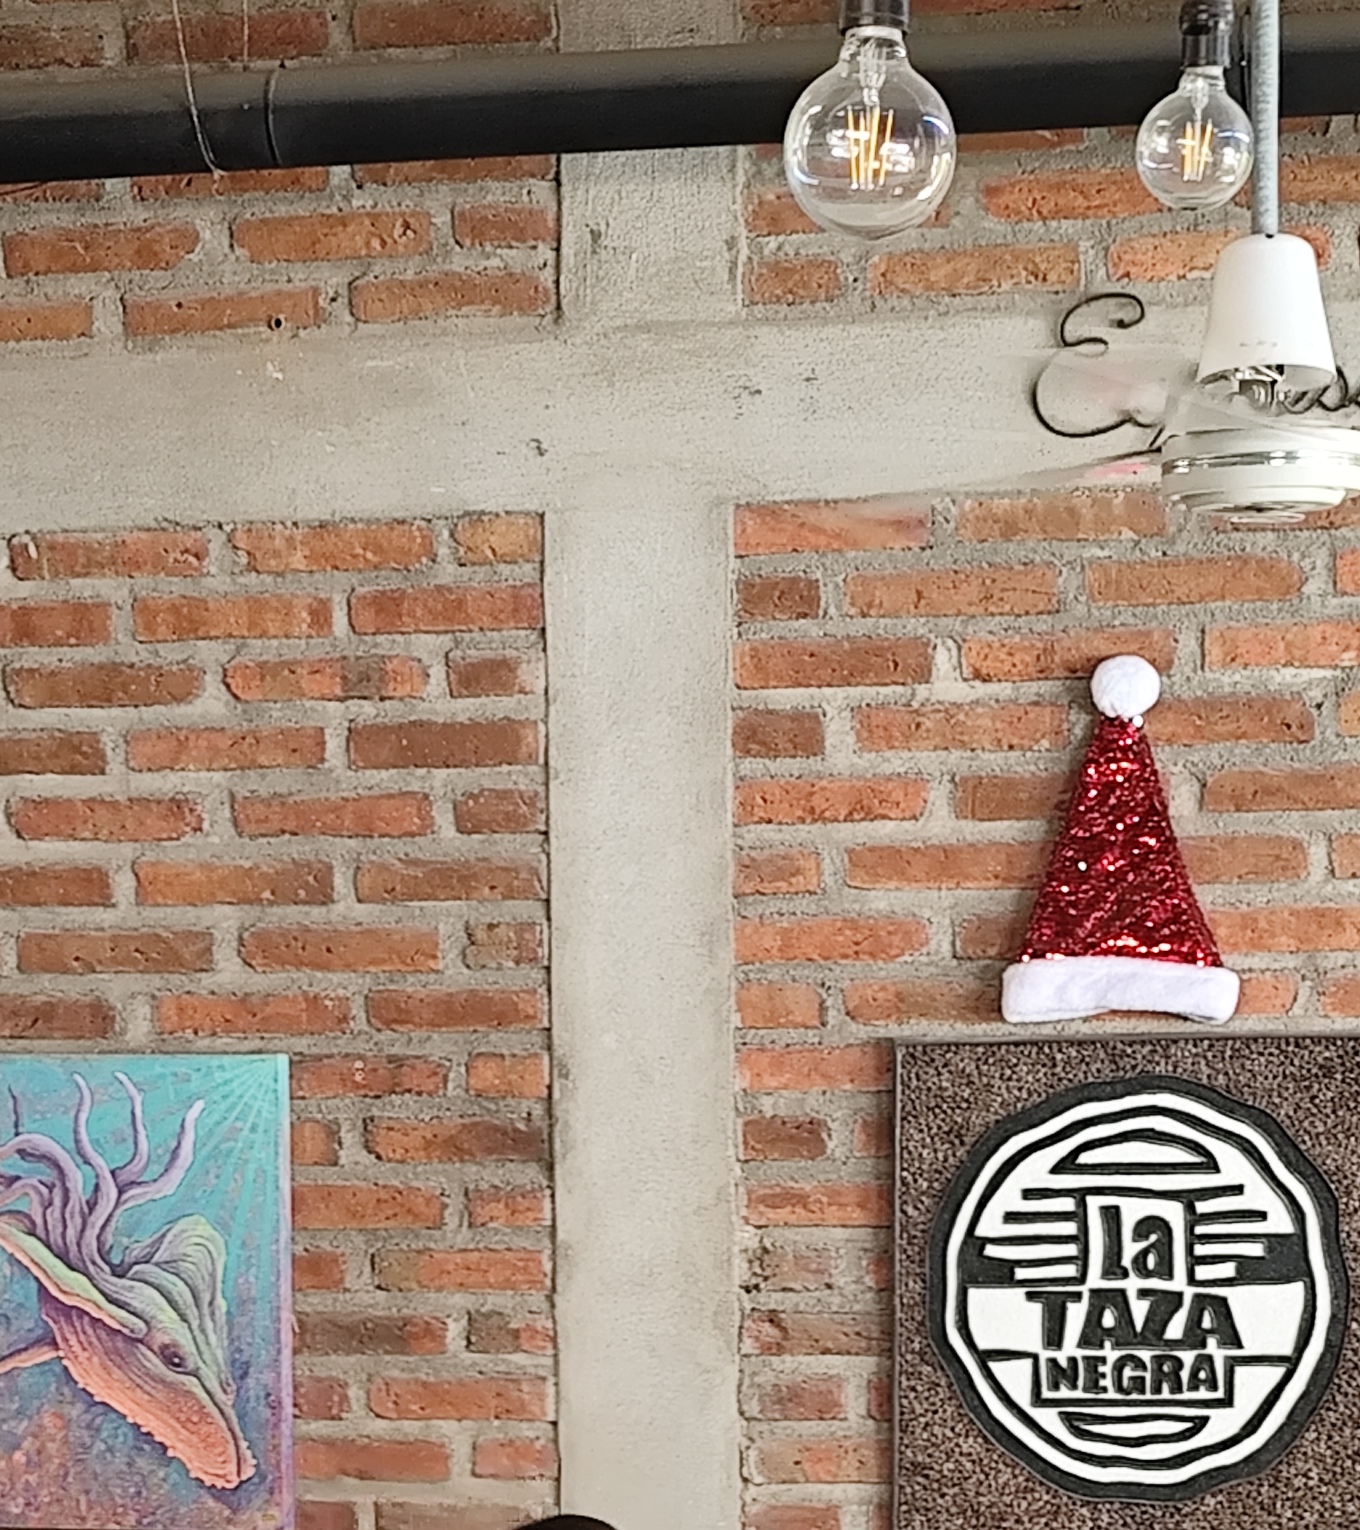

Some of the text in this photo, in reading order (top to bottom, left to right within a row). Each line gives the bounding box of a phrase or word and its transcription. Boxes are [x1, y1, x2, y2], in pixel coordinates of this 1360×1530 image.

[1098, 1204, 1175, 1281] la
[1024, 1287, 1245, 1351] TAZA
[1044, 1353, 1220, 1396] NEGRA
